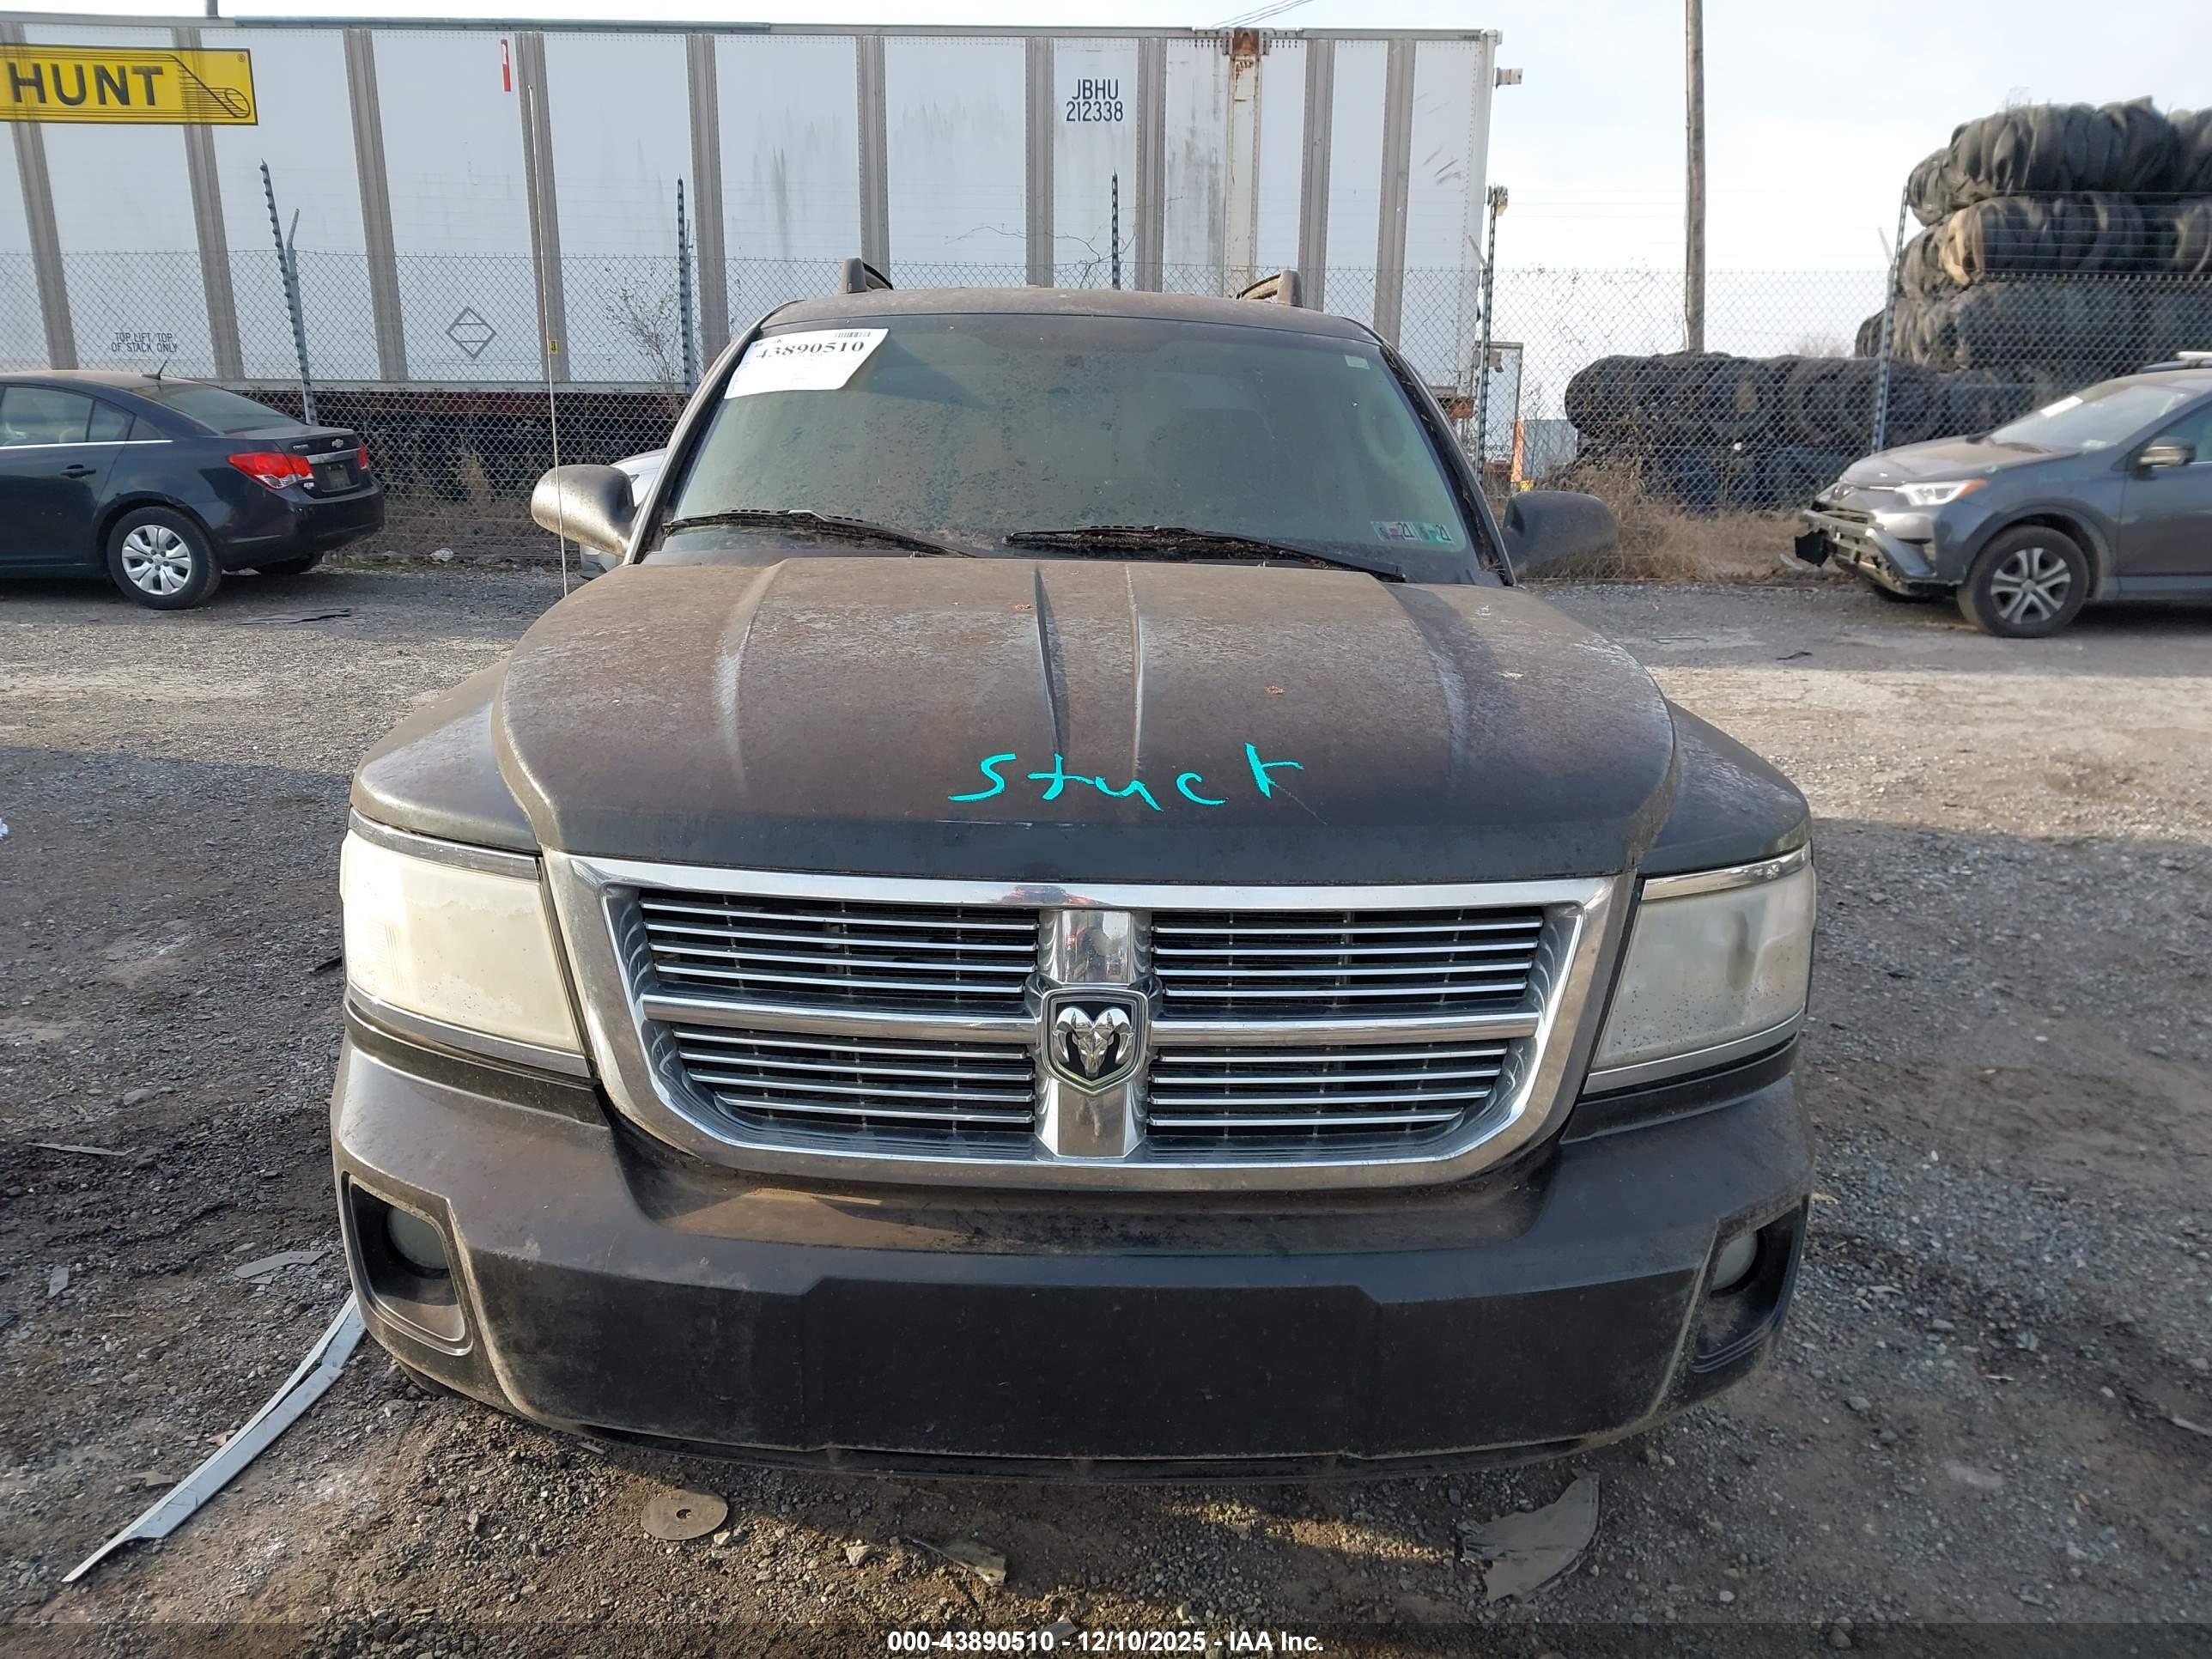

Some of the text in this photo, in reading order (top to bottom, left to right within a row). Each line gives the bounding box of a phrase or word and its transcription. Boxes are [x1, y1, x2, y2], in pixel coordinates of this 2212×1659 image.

[7, 61, 165, 106] HUNT
[1071, 78, 1119, 100] JBHU
[1066, 100, 1124, 122] 212338
[114, 331, 173, 343] TOP LIFT TOP
[111, 342, 178, 353] OF STACK ONLY
[756, 341, 865, 360] 43890510
